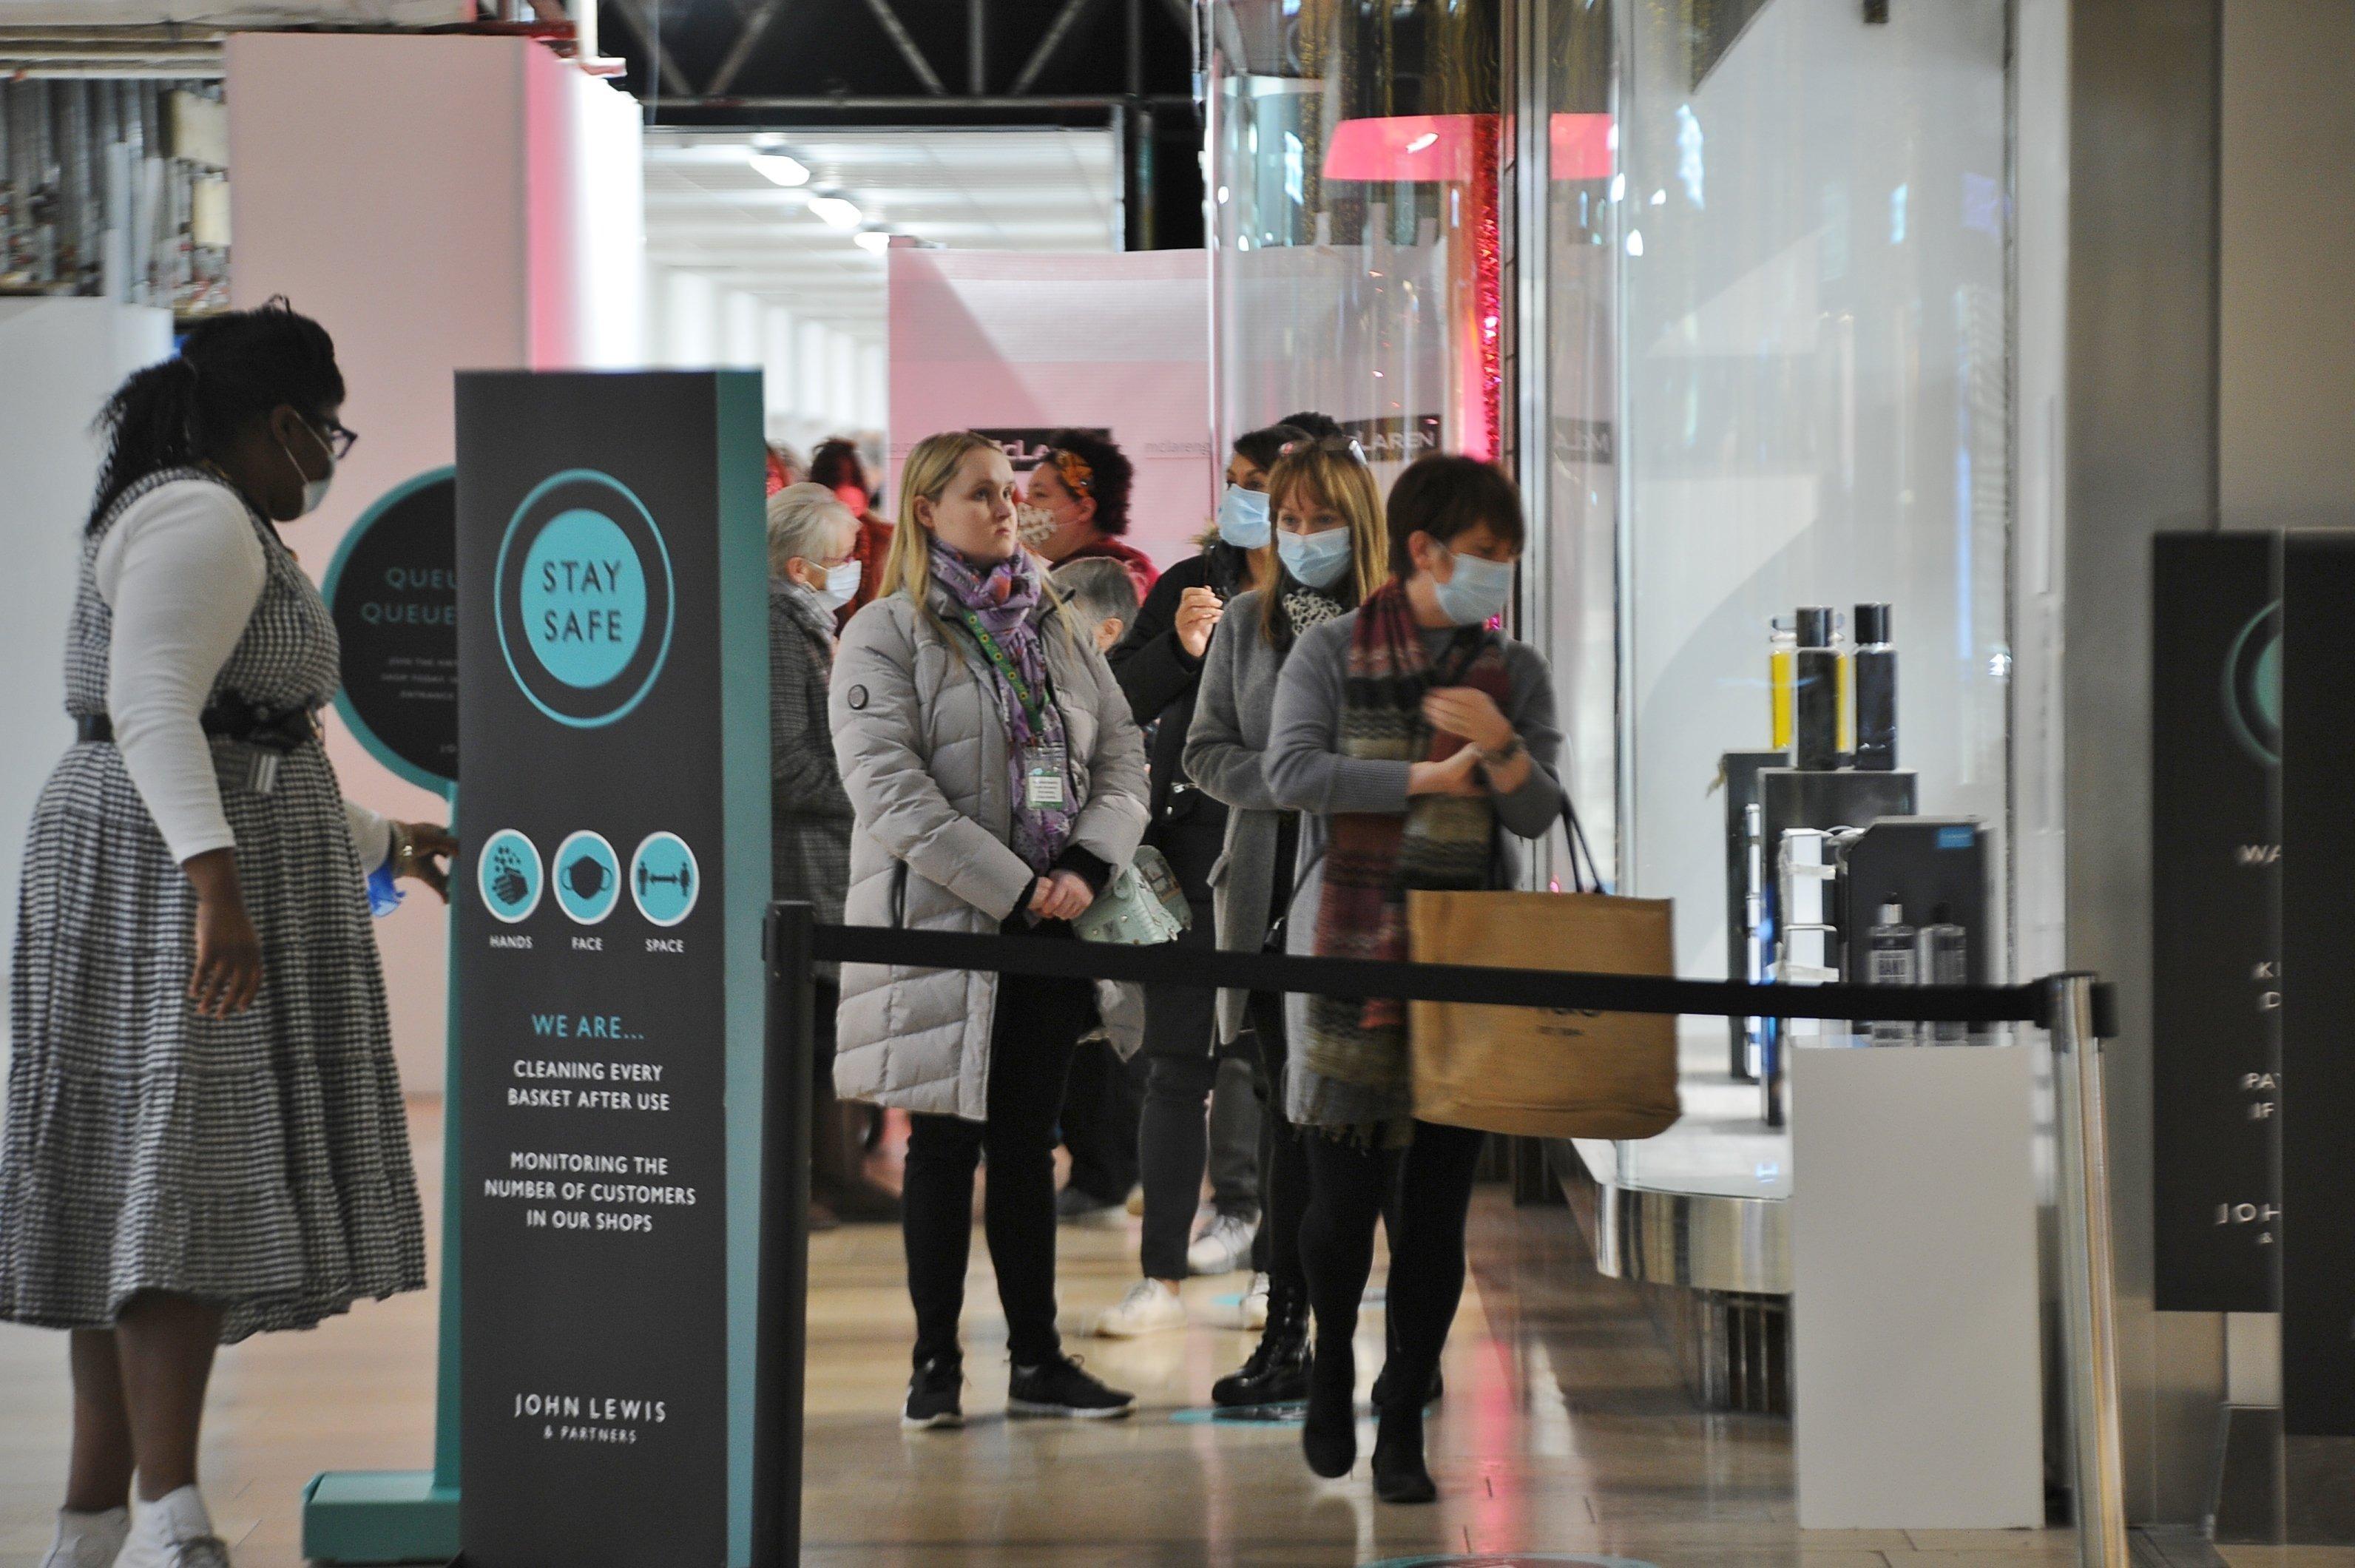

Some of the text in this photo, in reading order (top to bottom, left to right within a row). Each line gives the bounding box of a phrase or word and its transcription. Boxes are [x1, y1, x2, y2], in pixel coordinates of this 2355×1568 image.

[543, 559, 623, 593] STAY
[544, 609, 622, 642] SAFE
[489, 935, 533, 950] HANDS
[571, 936, 604, 951] FACE
[645, 938, 685, 953] SPACE
[532, 1014, 644, 1039] WE ARE...
[513, 1059, 663, 1081] CLEANING EVERY
[507, 1087, 670, 1111] BASKET AFTER USE
[510, 1152, 669, 1175] MONITORING THE
[484, 1179, 696, 1206] NUMBER OF CUSTOMERS
[526, 1209, 652, 1232] IN OUR SHOPS
[514, 1393, 666, 1423] JOHN LEWIS
[543, 1425, 637, 1444] & PARTNERS
